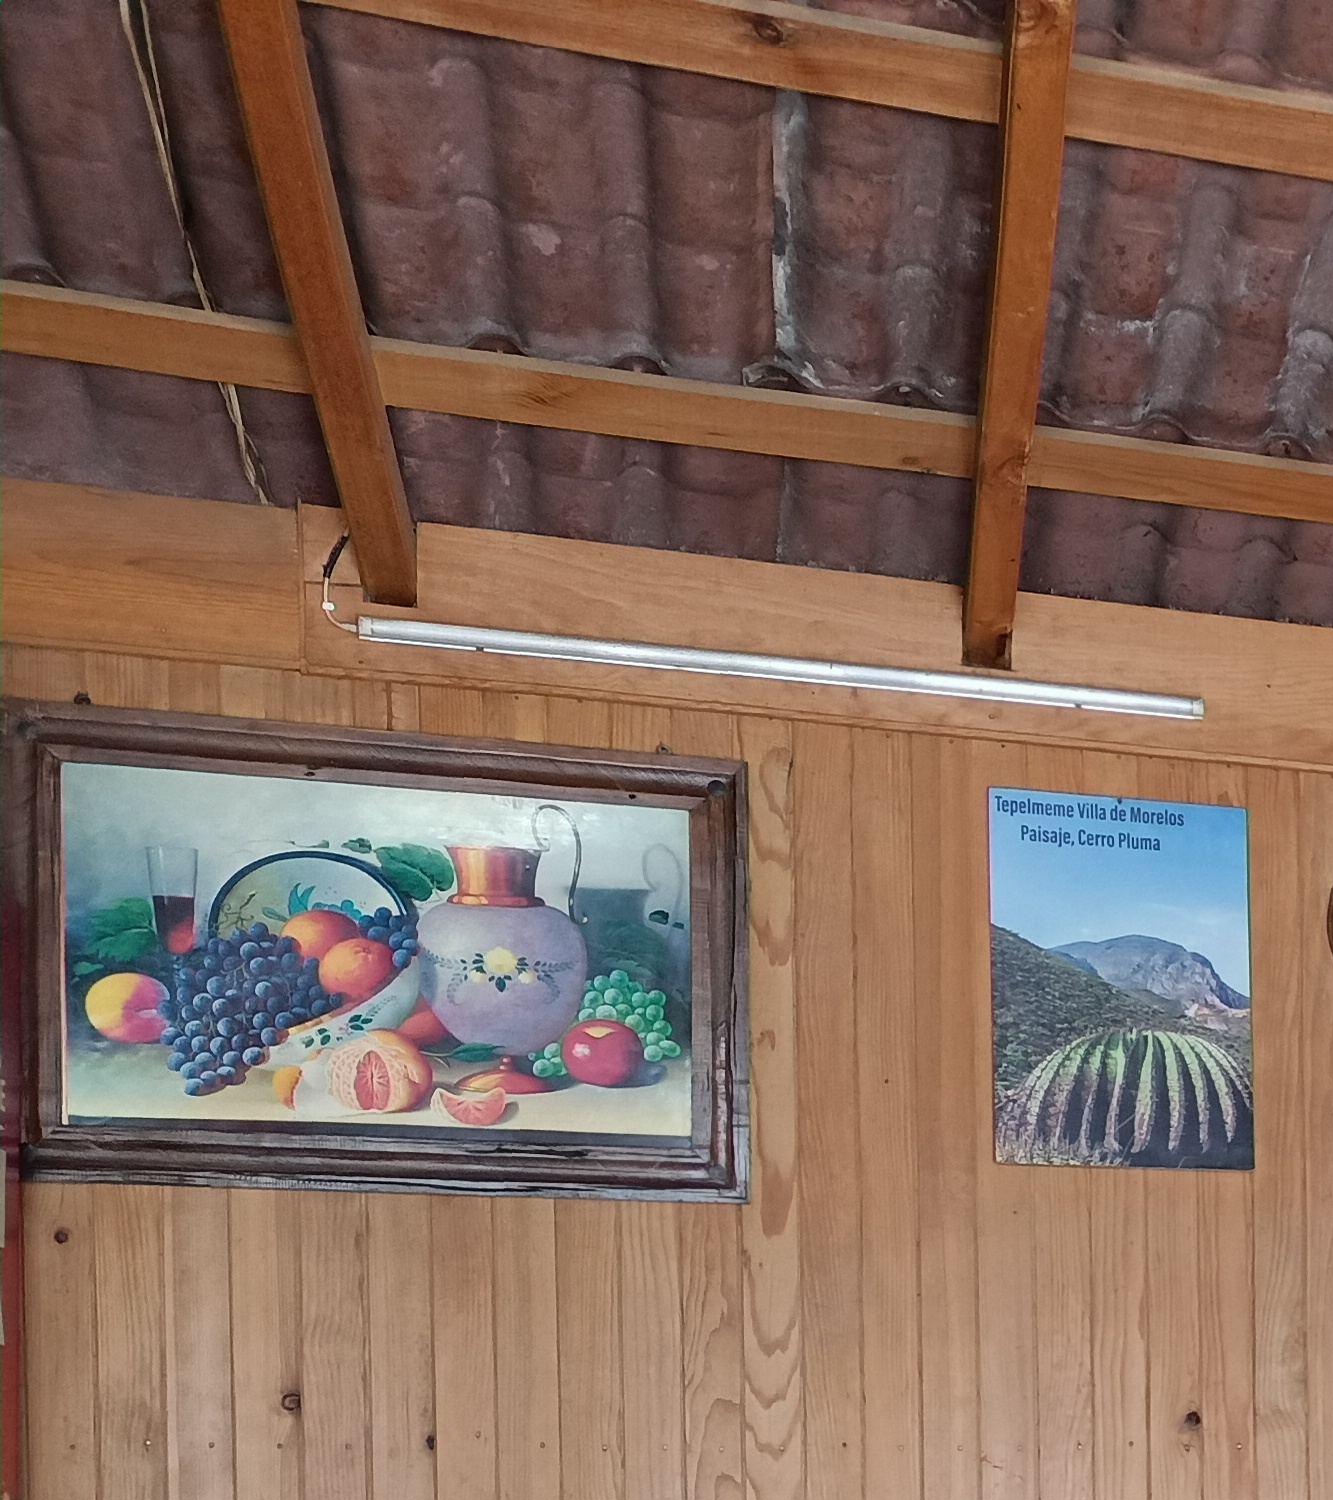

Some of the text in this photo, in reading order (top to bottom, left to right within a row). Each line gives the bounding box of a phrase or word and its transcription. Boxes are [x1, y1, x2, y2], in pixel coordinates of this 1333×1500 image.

[995, 795, 1185, 827] Tepelmeme Villa de Morelos
[1020, 825, 1161, 851] Paisaje, Cerro Pluma
